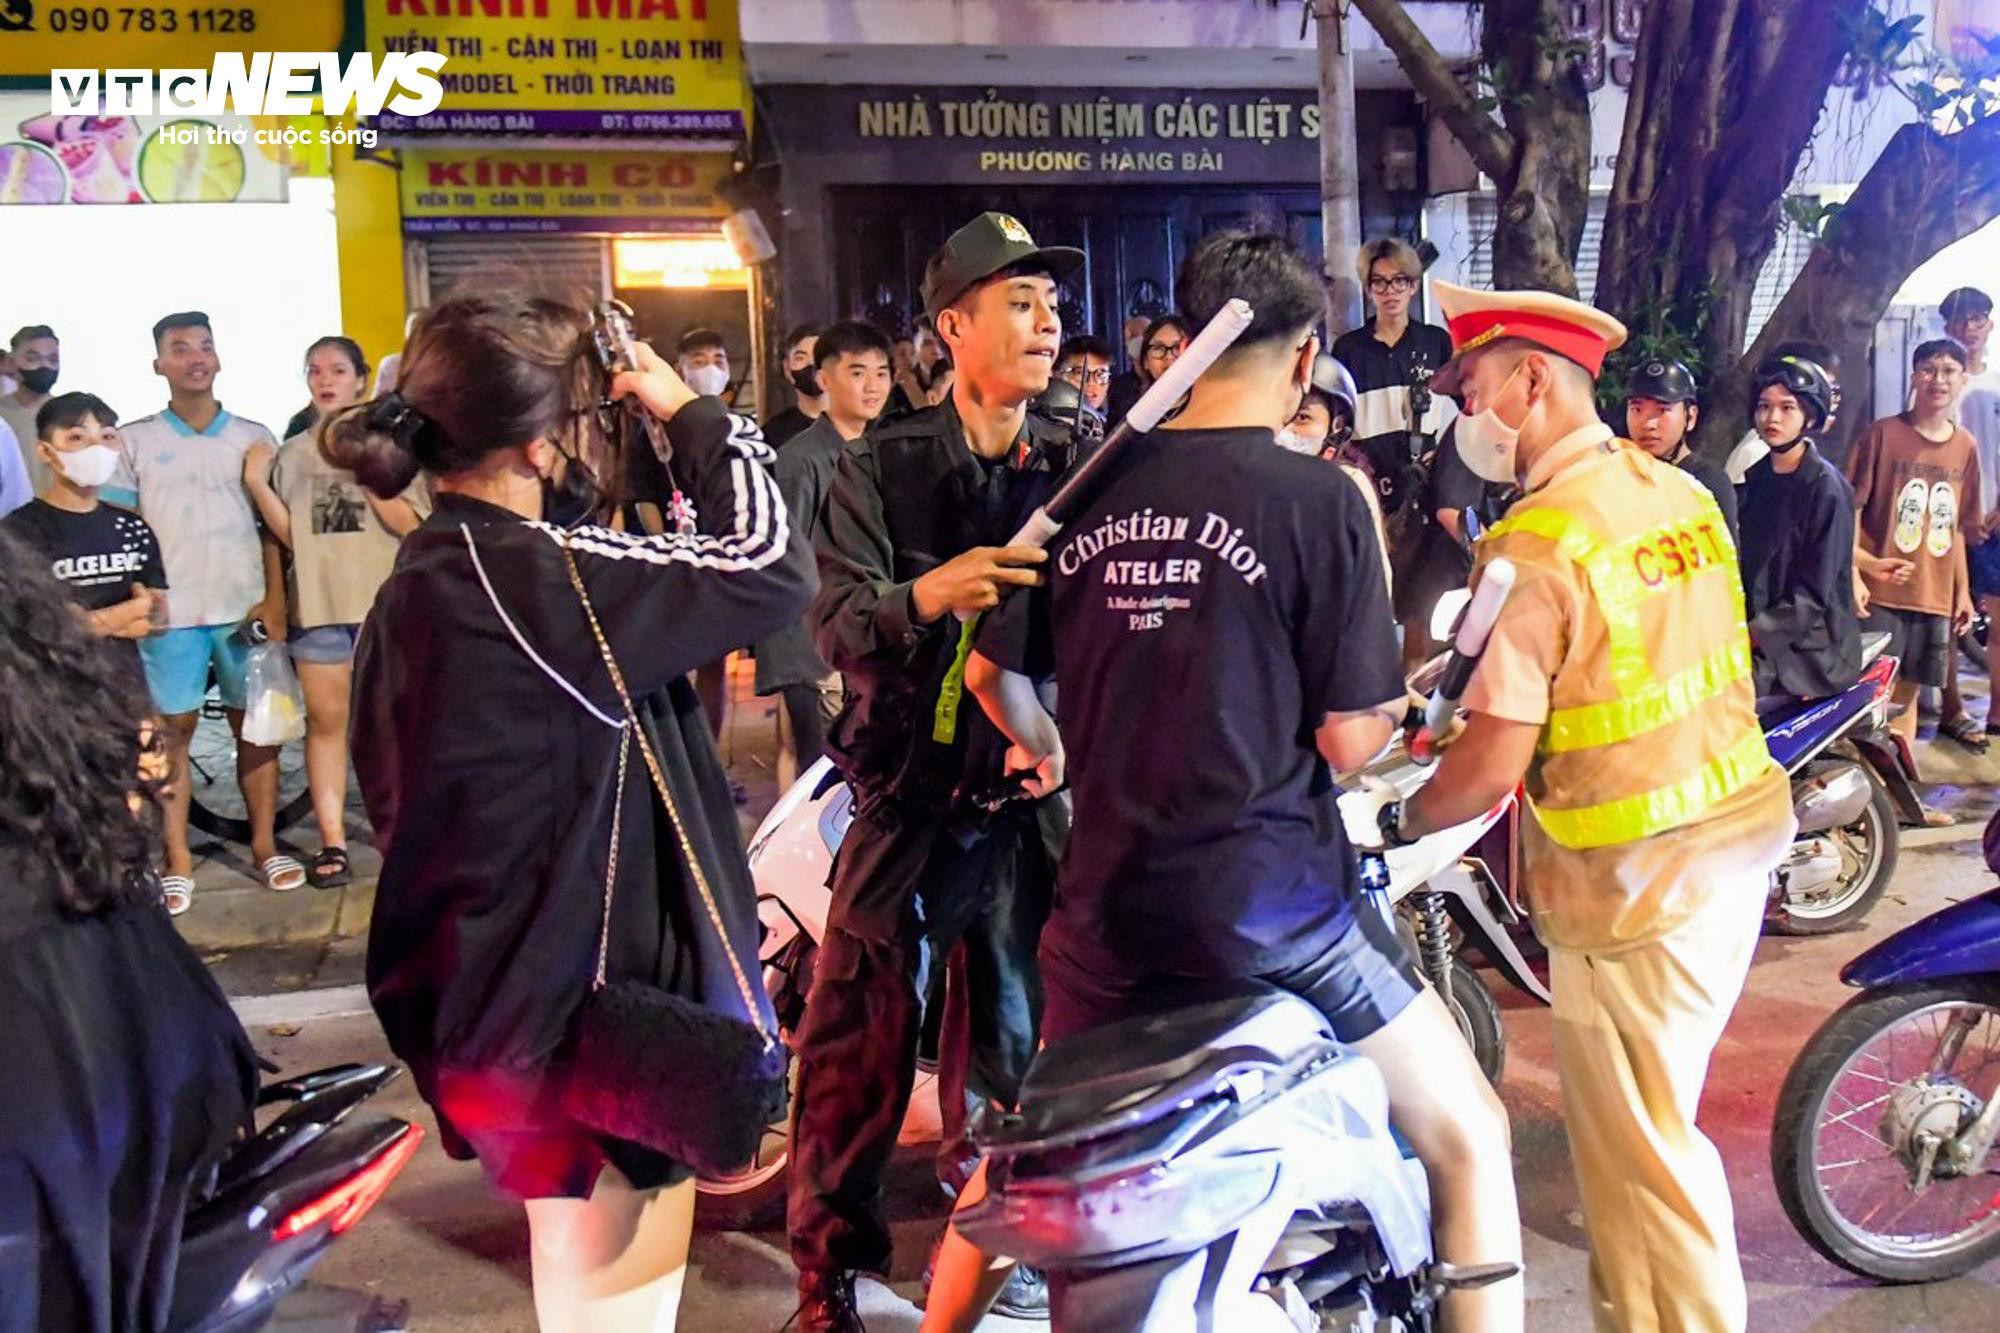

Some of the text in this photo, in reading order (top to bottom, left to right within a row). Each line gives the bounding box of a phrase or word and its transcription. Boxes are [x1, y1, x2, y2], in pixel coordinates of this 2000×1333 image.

[50, 8, 256, 33] 090 783 1128
[446, 37, 482, 62] THỊ
[439, 73, 518, 94] MODEL
[602, 75, 675, 95] TRANG
[858, 94, 932, 137] NHÀ
[939, 88, 1050, 138] TƯỞNG
[1060, 95, 1145, 144] NIỆM
[1155, 96, 1219, 138] CÁC
[1228, 96, 1291, 145] LIỆT
[980, 147, 1223, 171] PHƯỜNG HÀNG BÀI
[428, 156, 588, 188] KÍNH
[1196, 512, 1267, 586] Dior
